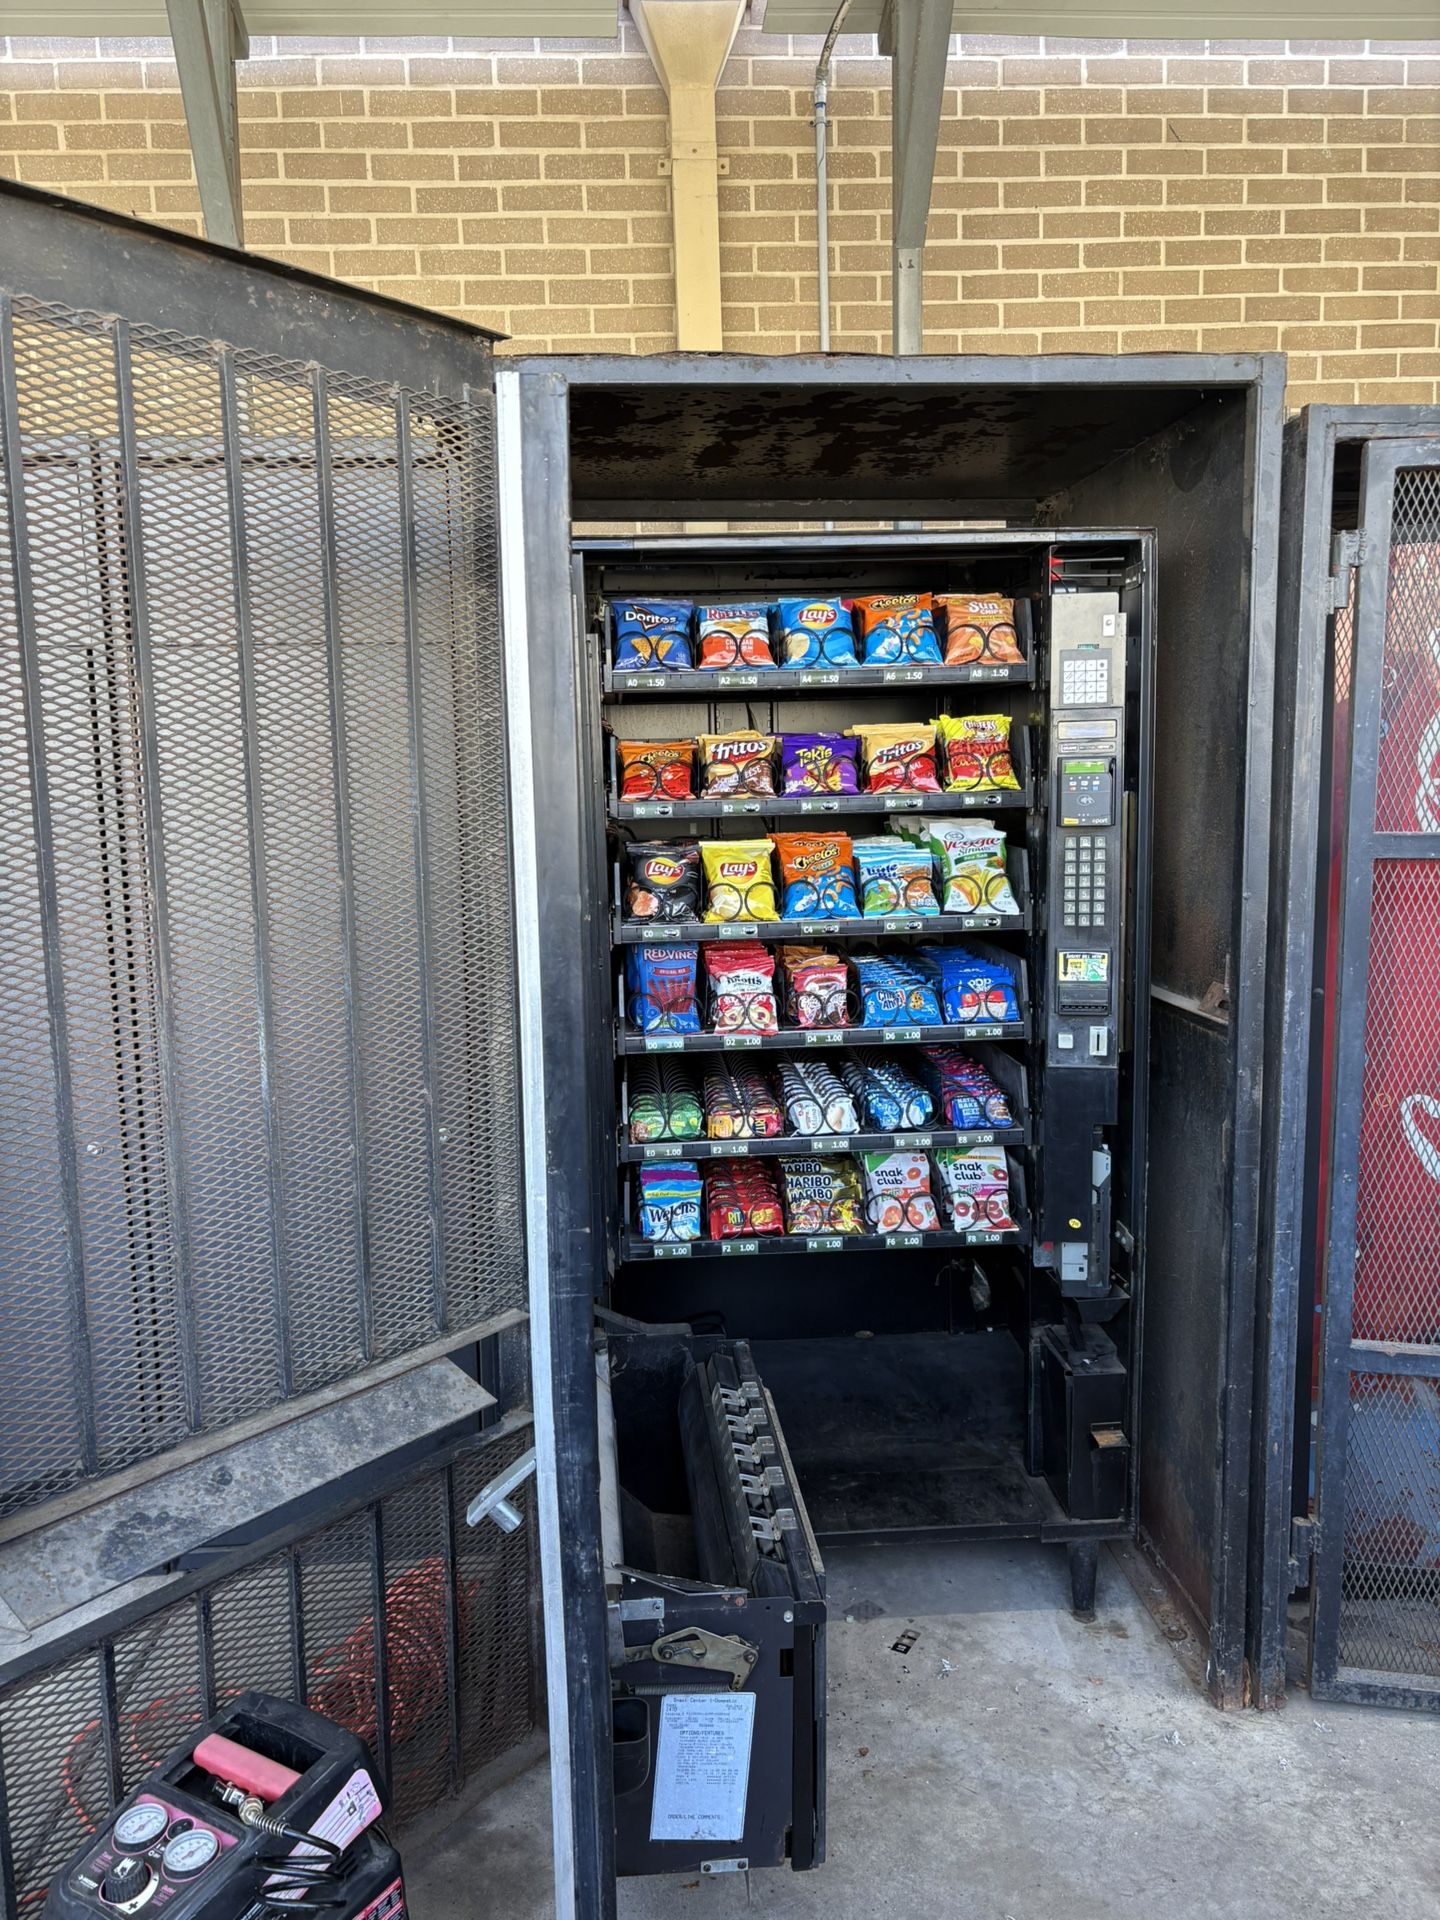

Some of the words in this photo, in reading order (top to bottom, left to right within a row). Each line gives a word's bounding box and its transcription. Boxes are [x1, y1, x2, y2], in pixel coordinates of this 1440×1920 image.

[872, 595, 918, 608] Cheetos
[969, 601, 998, 613] Sun
[625, 611, 678, 623] Doritos
[628, 679, 638, 687] A0
[720, 676, 731, 684] A2
[801, 675, 812, 683] A4
[711, 742, 766, 760] Fritos
[876, 741, 922, 764] Fritos
[795, 748, 832, 767] Takis
[943, 837, 1000, 852] Veggie
[794, 848, 839, 869] Cheetos
[644, 949, 666, 961] RED
[667, 949, 698, 960] VINES
[967, 978, 992, 992] POP
[967, 1029, 977, 1037] D8
[807, 1035, 817, 1043] D4
[958, 1136, 967, 1144] E8
[813, 1141, 823, 1149] E4
[713, 1146, 722, 1154] E2
[953, 1162, 983, 1171] snak
[875, 1167, 903, 1177] snak
[954, 1171, 982, 1181] club
[786, 1175, 833, 1188] HARIBO
[877, 1177, 903, 1186] club
[887, 1238, 896, 1246] F6
[904, 1237, 919, 1245] 1.00
[985, 1234, 1000, 1242] 1.00
[809, 1241, 818, 1249] F4
[826, 1240, 841, 1248] 1.00
[655, 1248, 664, 1256] F0
